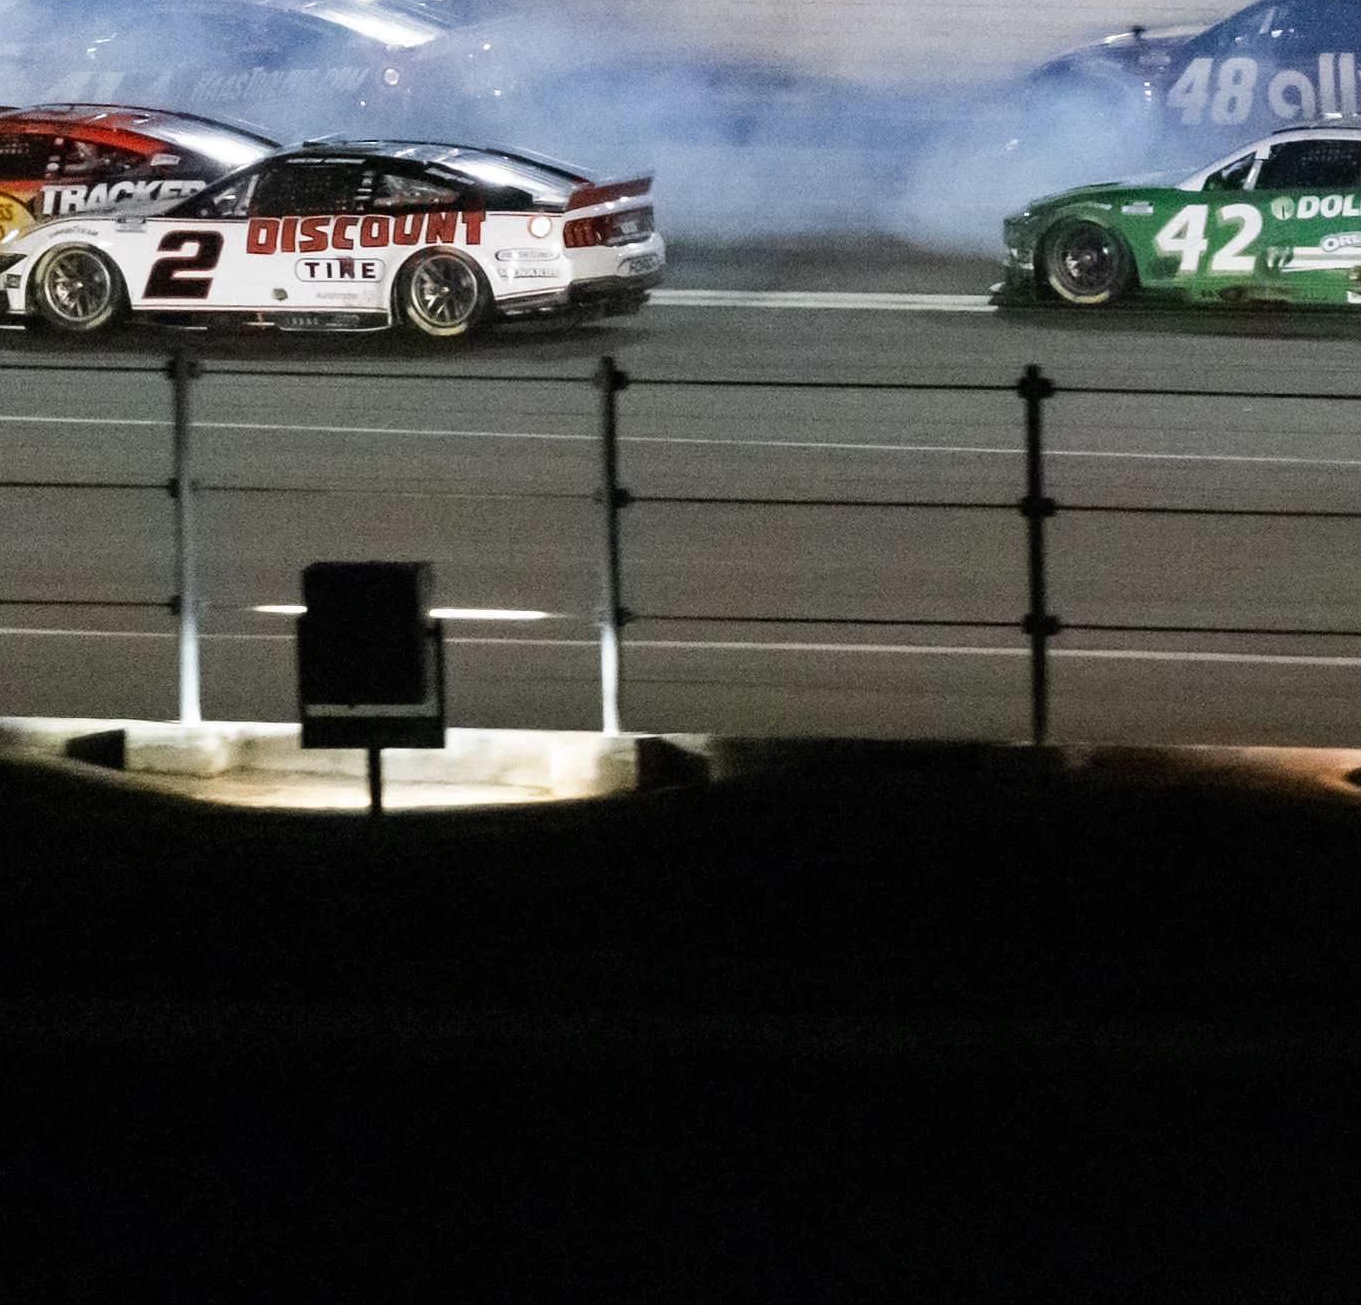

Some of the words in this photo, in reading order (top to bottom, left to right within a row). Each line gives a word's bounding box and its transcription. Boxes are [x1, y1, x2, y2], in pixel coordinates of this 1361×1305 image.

[1166, 57, 1258, 125] 48
[142, 229, 224, 299] 2
[247, 210, 486, 255] DISCOUNT
[1154, 203, 1263, 276] 42
[304, 259, 376, 279] TIRE
